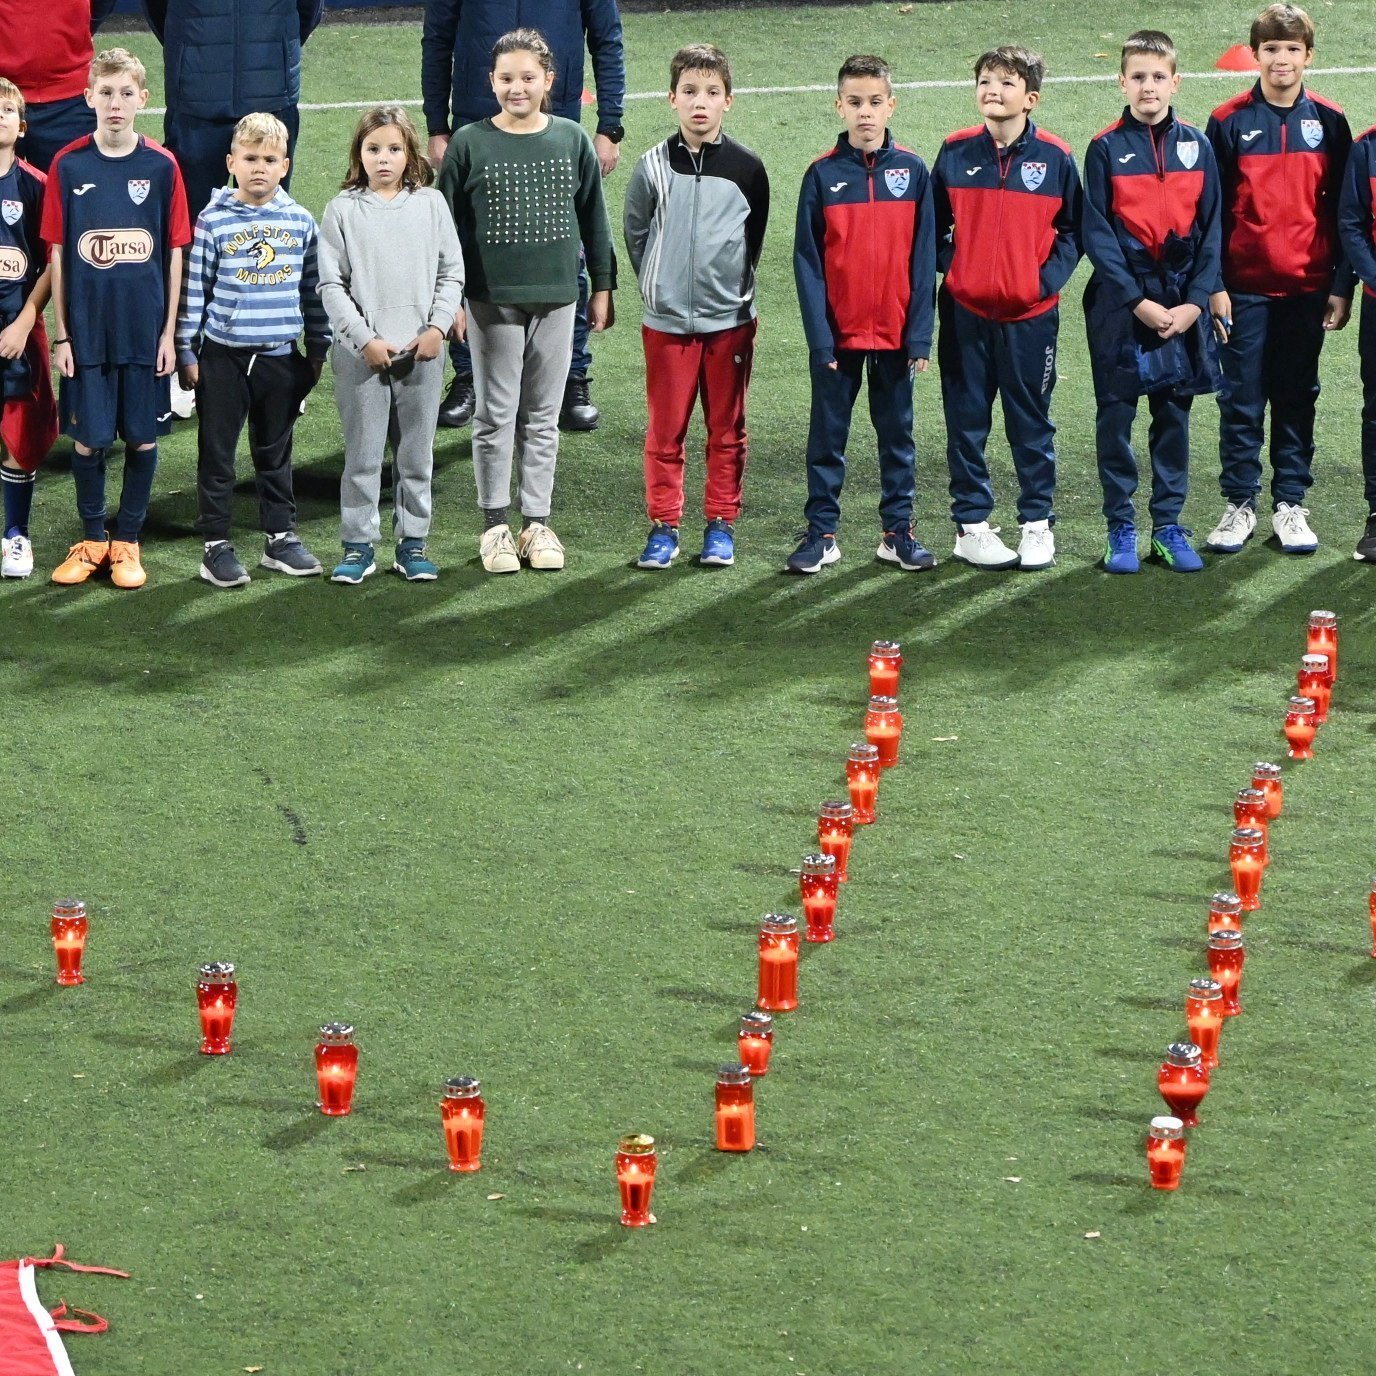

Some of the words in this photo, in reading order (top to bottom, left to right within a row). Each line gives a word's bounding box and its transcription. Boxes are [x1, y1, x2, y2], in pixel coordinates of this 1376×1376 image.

[88, 234, 147, 265] Tarsa
[224, 224, 260, 256] WOLF
[235, 264, 293, 286] MOTORS
[1039, 344, 1055, 395] Joma
